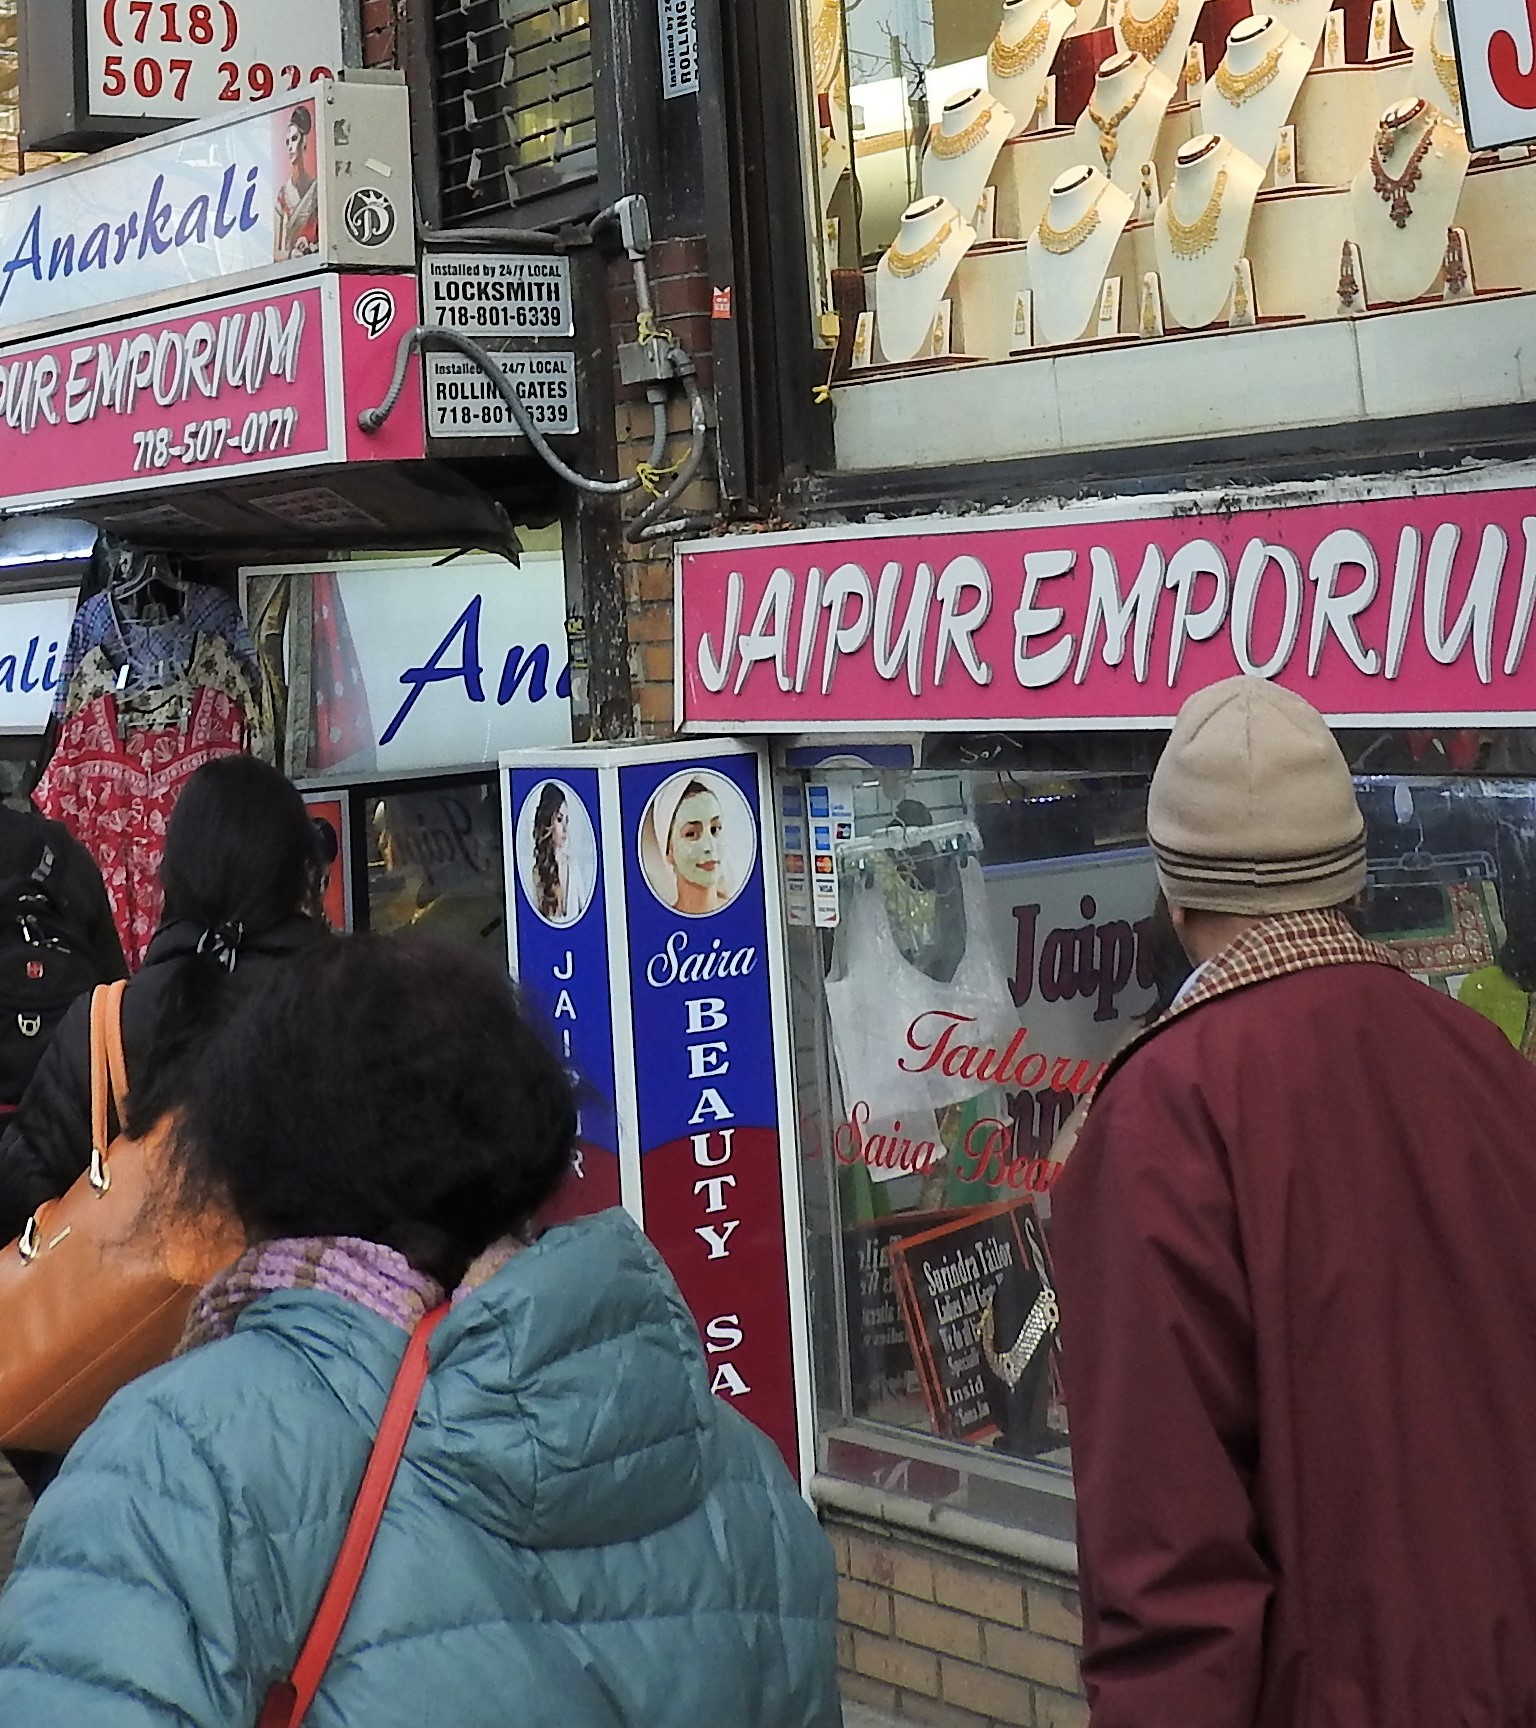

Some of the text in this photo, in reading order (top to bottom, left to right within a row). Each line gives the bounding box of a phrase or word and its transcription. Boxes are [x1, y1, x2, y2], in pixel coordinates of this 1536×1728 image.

[675, 0, 693, 85] ROLLING
[102, 56, 192, 104] 507
[430, 263, 562, 278] Installed by 24/7 LOCAL
[434, 280, 561, 302] LOCKSMITH
[435, 306, 562, 327] 718-801-6339
[65, 300, 307, 424] EMPORIUM
[529, 361, 568, 375] LOCAL
[515, 381, 568, 400] GATES
[437, 404, 569, 425] 718-8016339
[695, 551, 996, 696] JAIPUR
[645, 929, 758, 989] Saira
[684, 996, 741, 1262] BEAUTY
[834, 1099, 937, 1176] Saira
[974, 1235, 1014, 1277] Tailor
